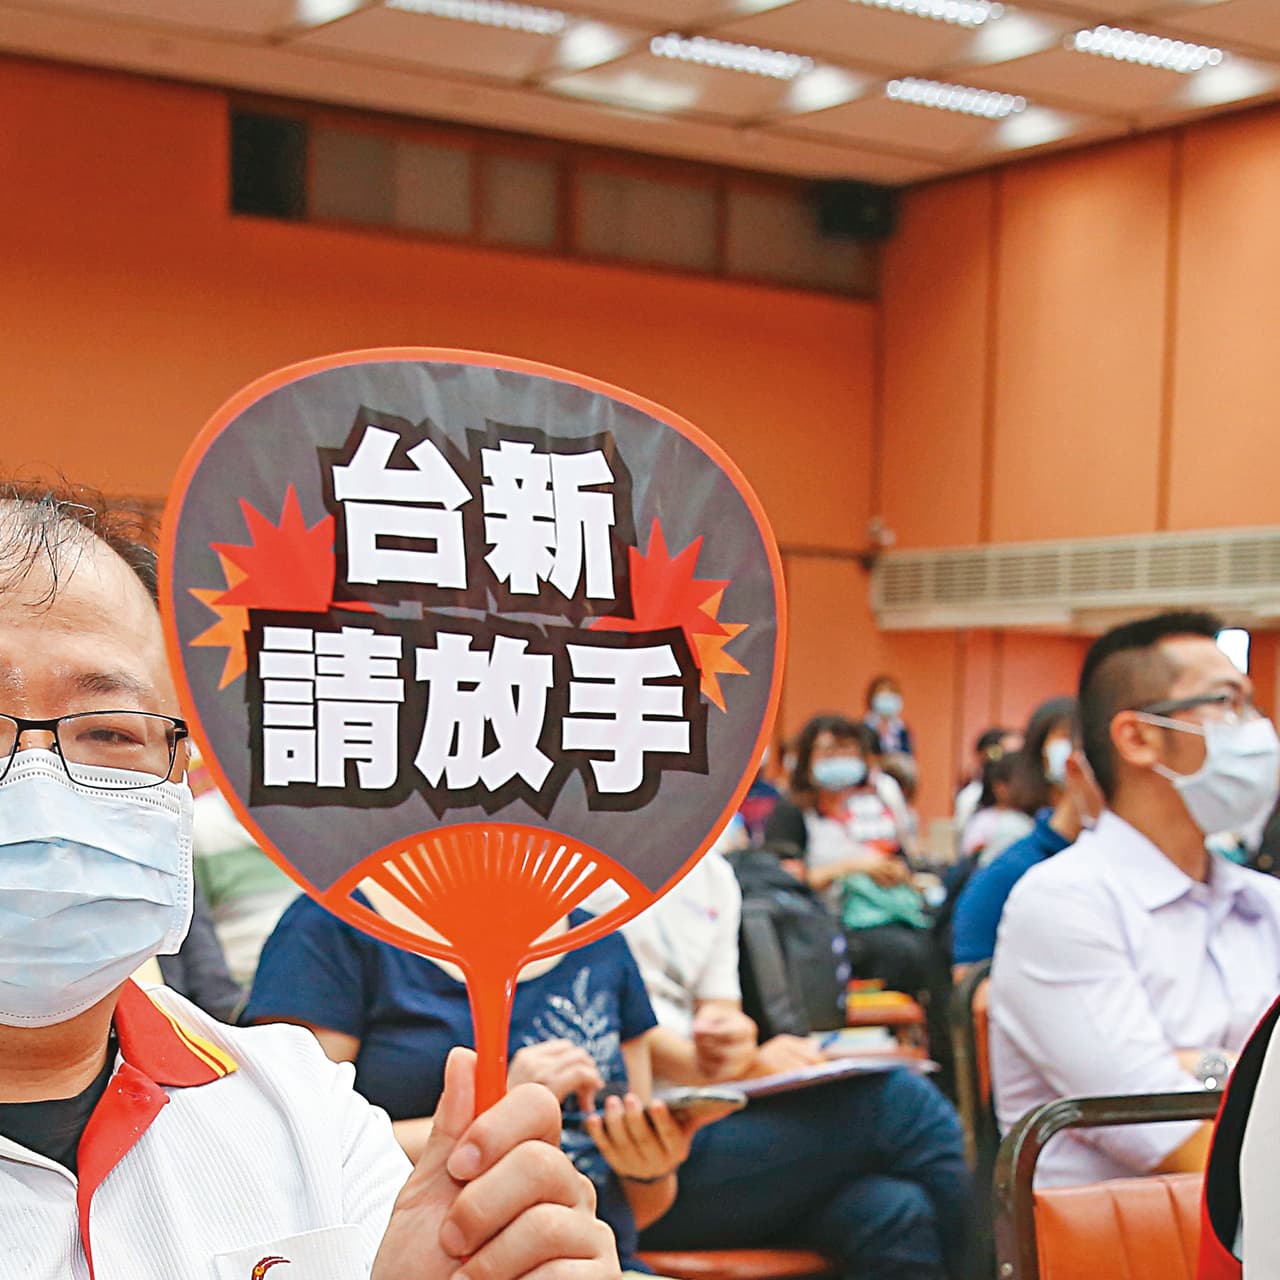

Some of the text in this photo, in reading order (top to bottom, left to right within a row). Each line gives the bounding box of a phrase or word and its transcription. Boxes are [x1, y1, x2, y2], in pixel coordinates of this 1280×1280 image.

[332, 425, 616, 600] 台新
[258, 625, 690, 795] 請放手
